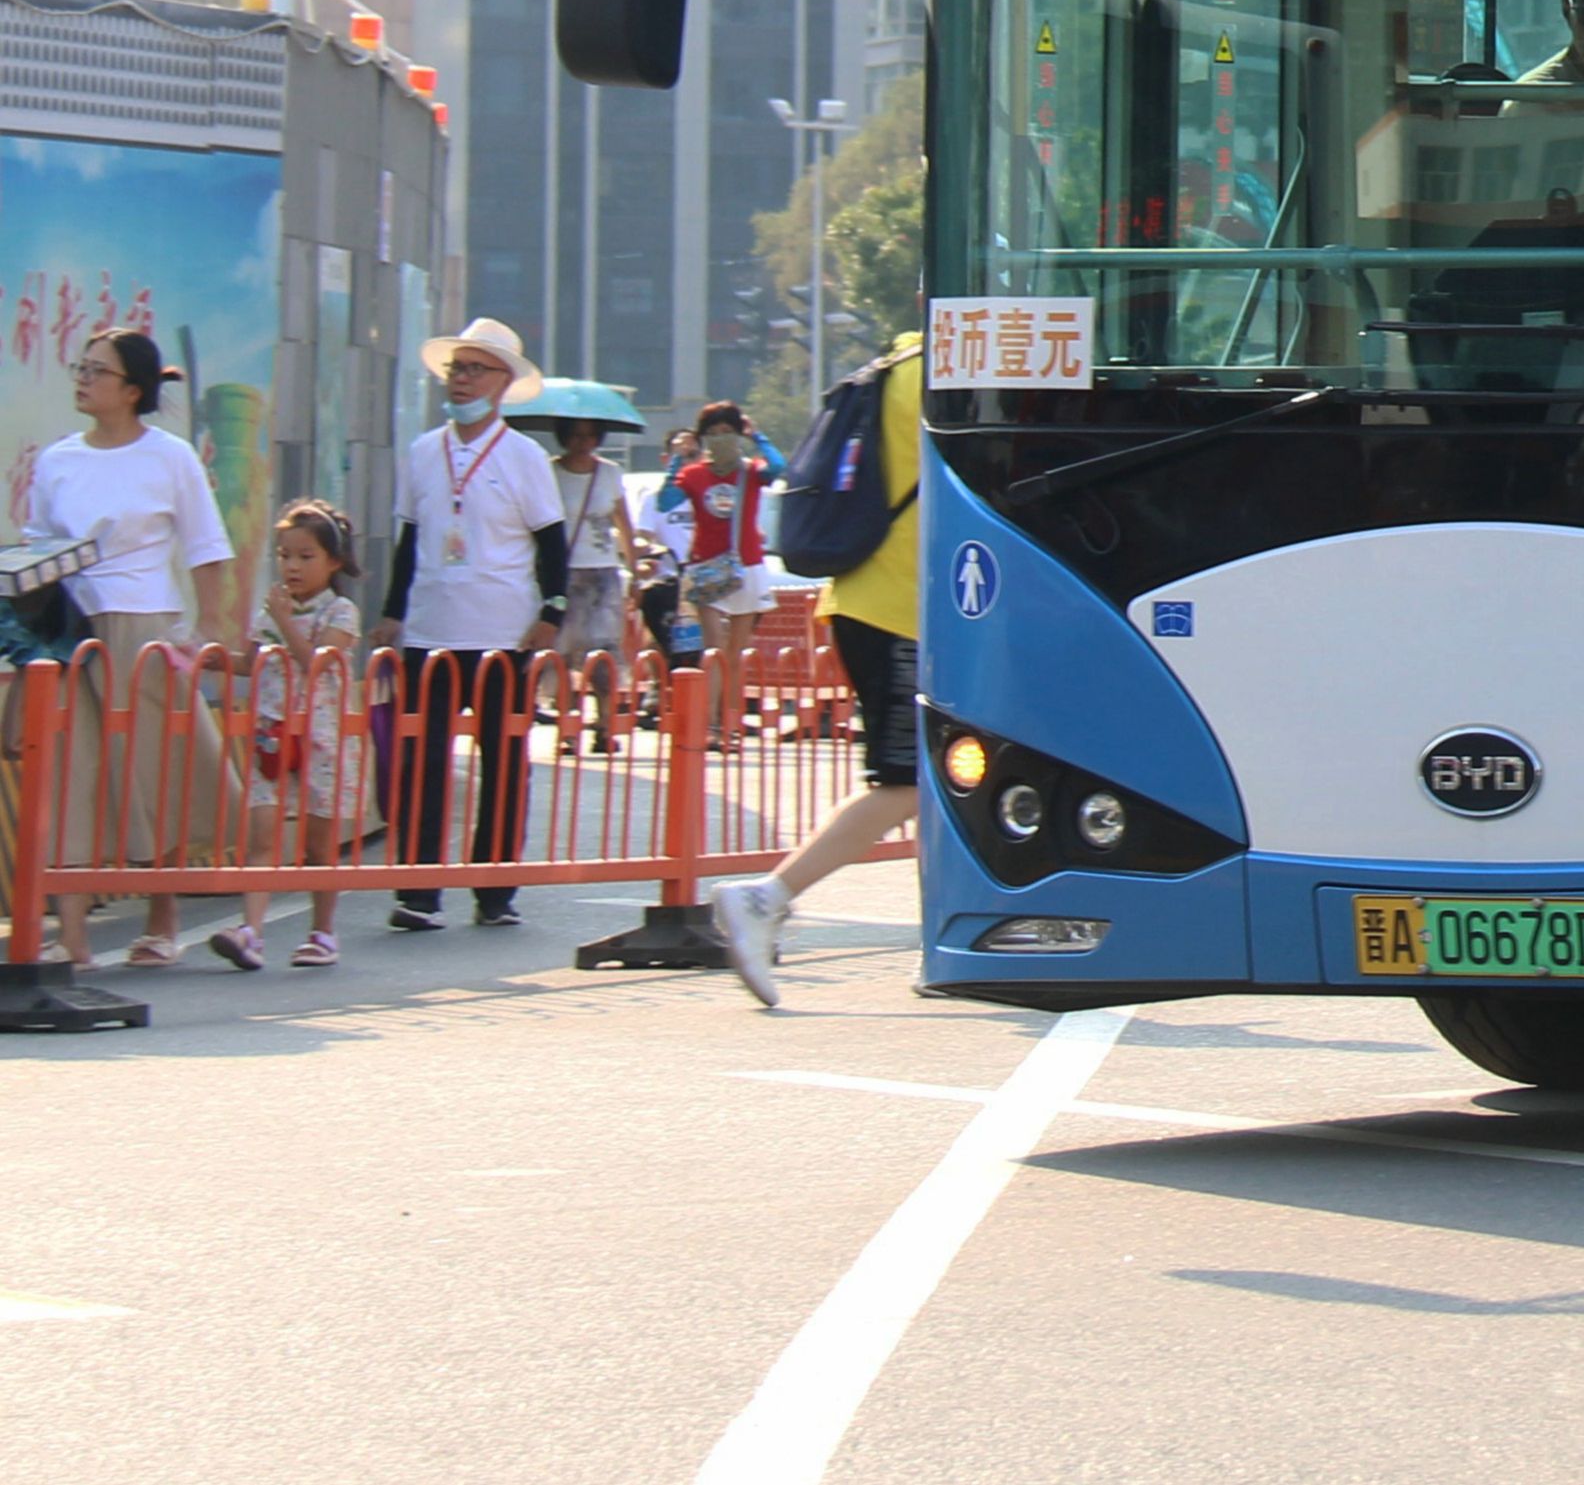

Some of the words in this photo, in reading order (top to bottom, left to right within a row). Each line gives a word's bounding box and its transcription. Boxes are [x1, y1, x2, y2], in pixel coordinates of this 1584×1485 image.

[934, 307, 1083, 379] 投币壹元
[1431, 755, 1525, 791] BYD
